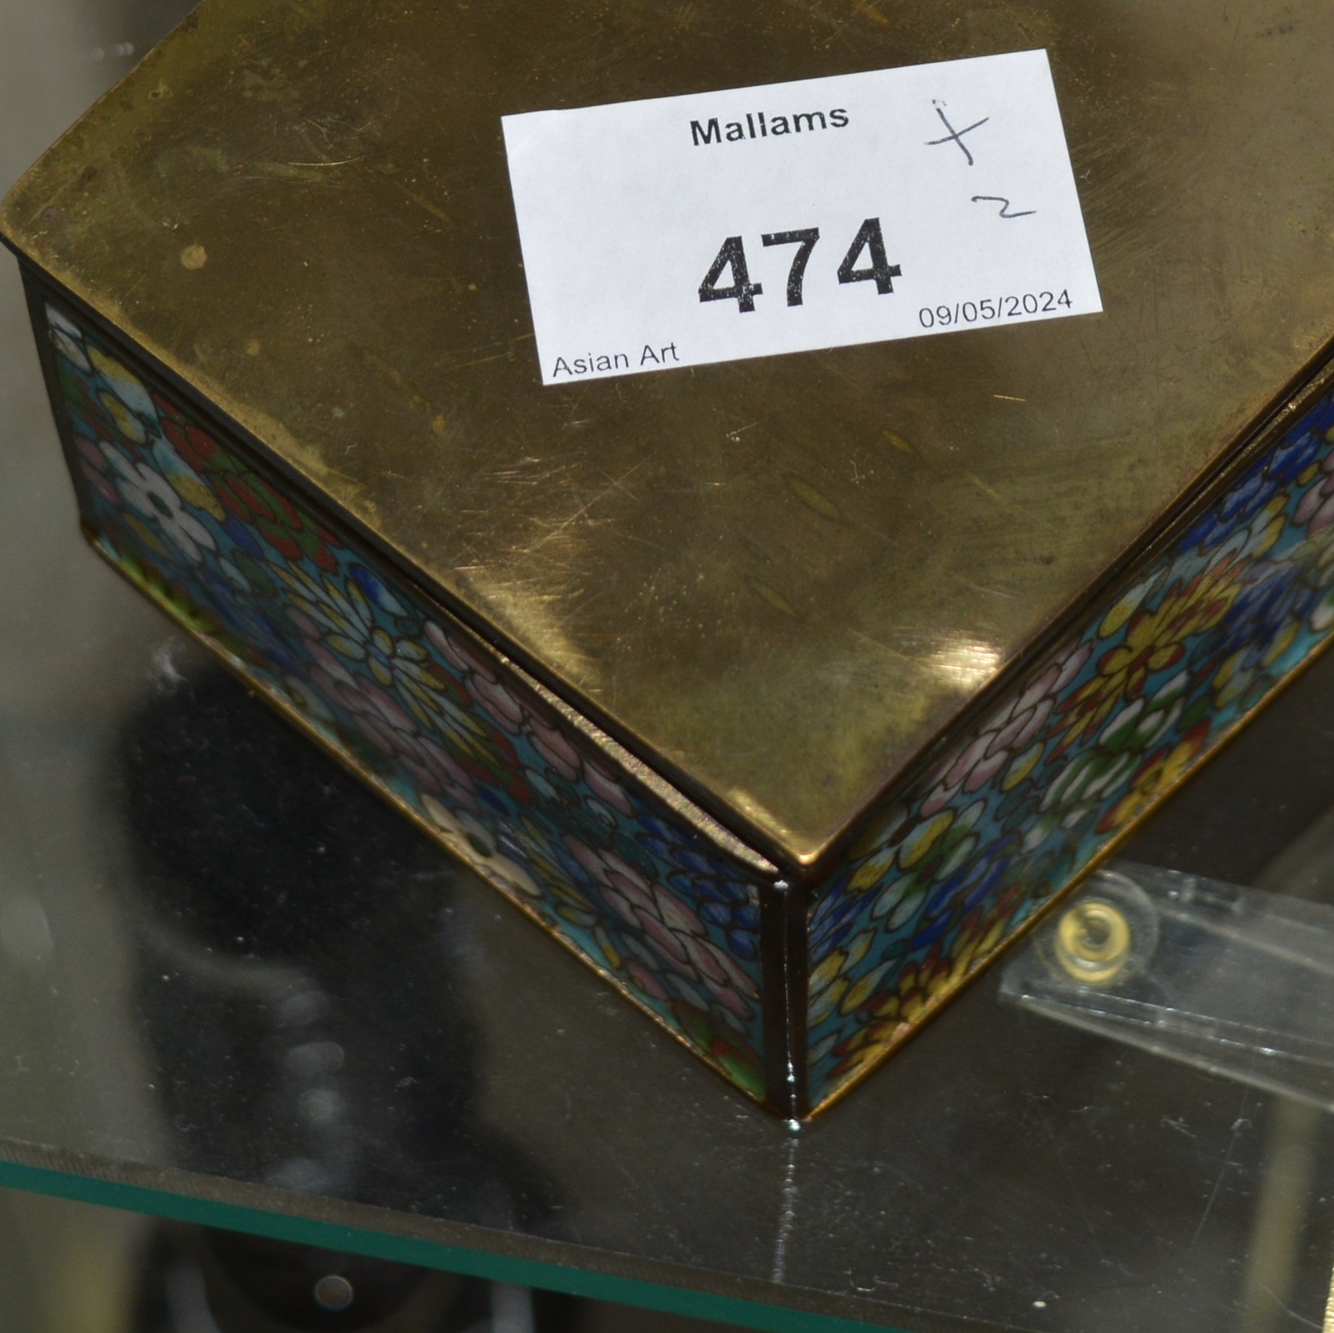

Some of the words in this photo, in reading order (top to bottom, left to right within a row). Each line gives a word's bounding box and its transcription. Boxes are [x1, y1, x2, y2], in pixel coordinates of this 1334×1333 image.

[689, 107, 850, 147] Mallams
[697, 216, 903, 314] 474
[918, 288, 1074, 330] 09/05/2024
[551, 352, 630, 378] Asian
[639, 341, 680, 367] Art
